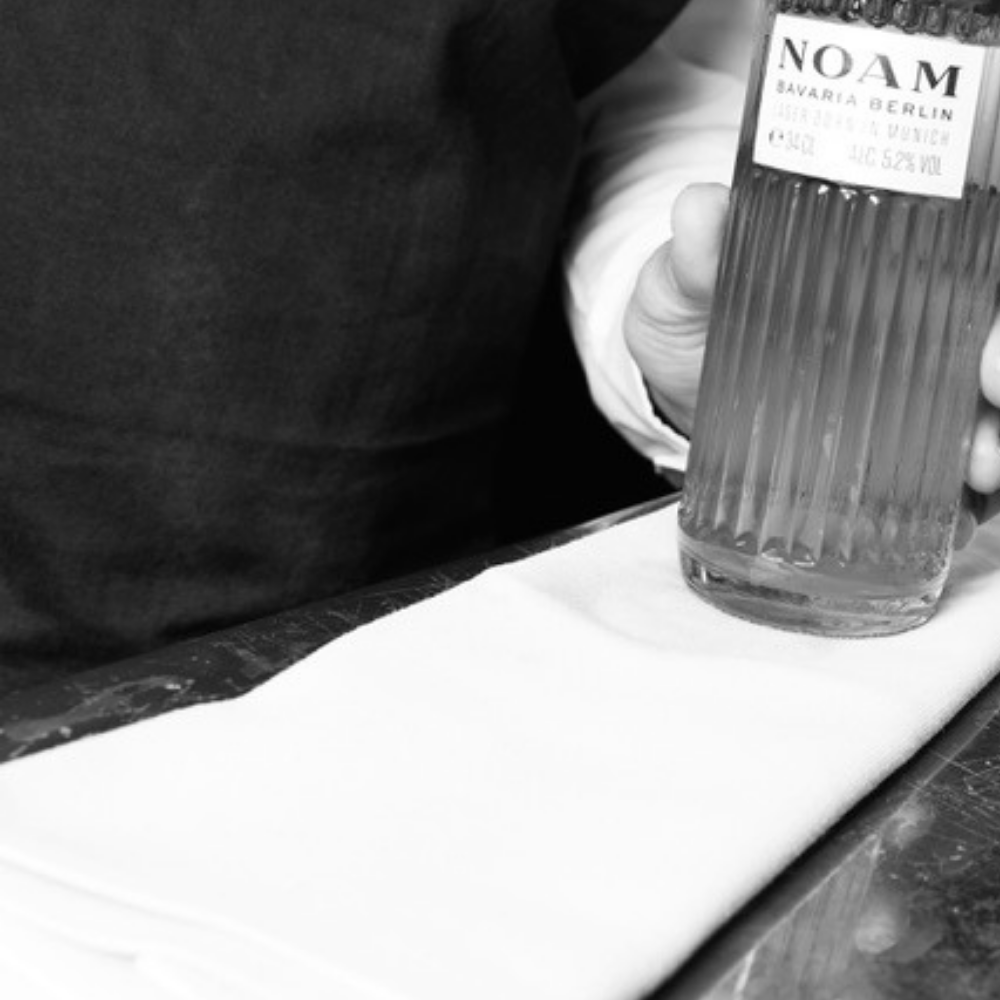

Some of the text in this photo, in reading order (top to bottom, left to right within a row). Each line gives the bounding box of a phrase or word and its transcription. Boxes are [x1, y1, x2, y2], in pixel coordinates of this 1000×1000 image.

[778, 37, 962, 98] NOAM
[776, 79, 858, 107] BAVARIA
[869, 98, 953, 121] BERLIN
